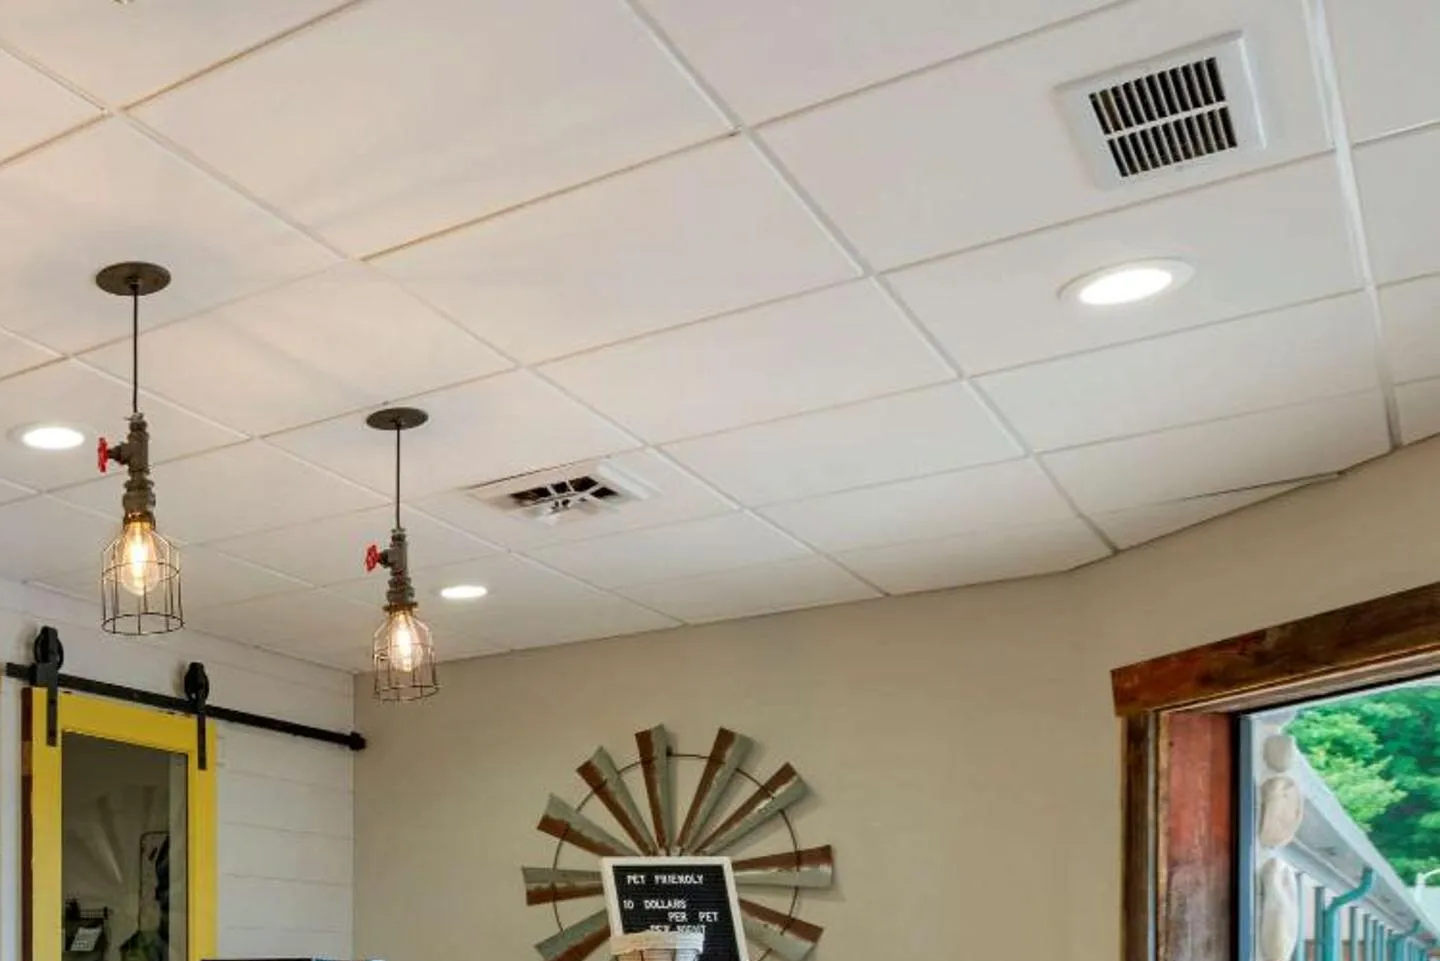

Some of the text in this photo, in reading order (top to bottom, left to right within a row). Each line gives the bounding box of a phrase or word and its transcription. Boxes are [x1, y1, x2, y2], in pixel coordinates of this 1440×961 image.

[626, 874, 704, 885] PET FRIENDLY
[623, 899, 687, 909] 10 DOLLARS
[668, 911, 719, 922] PER PET
